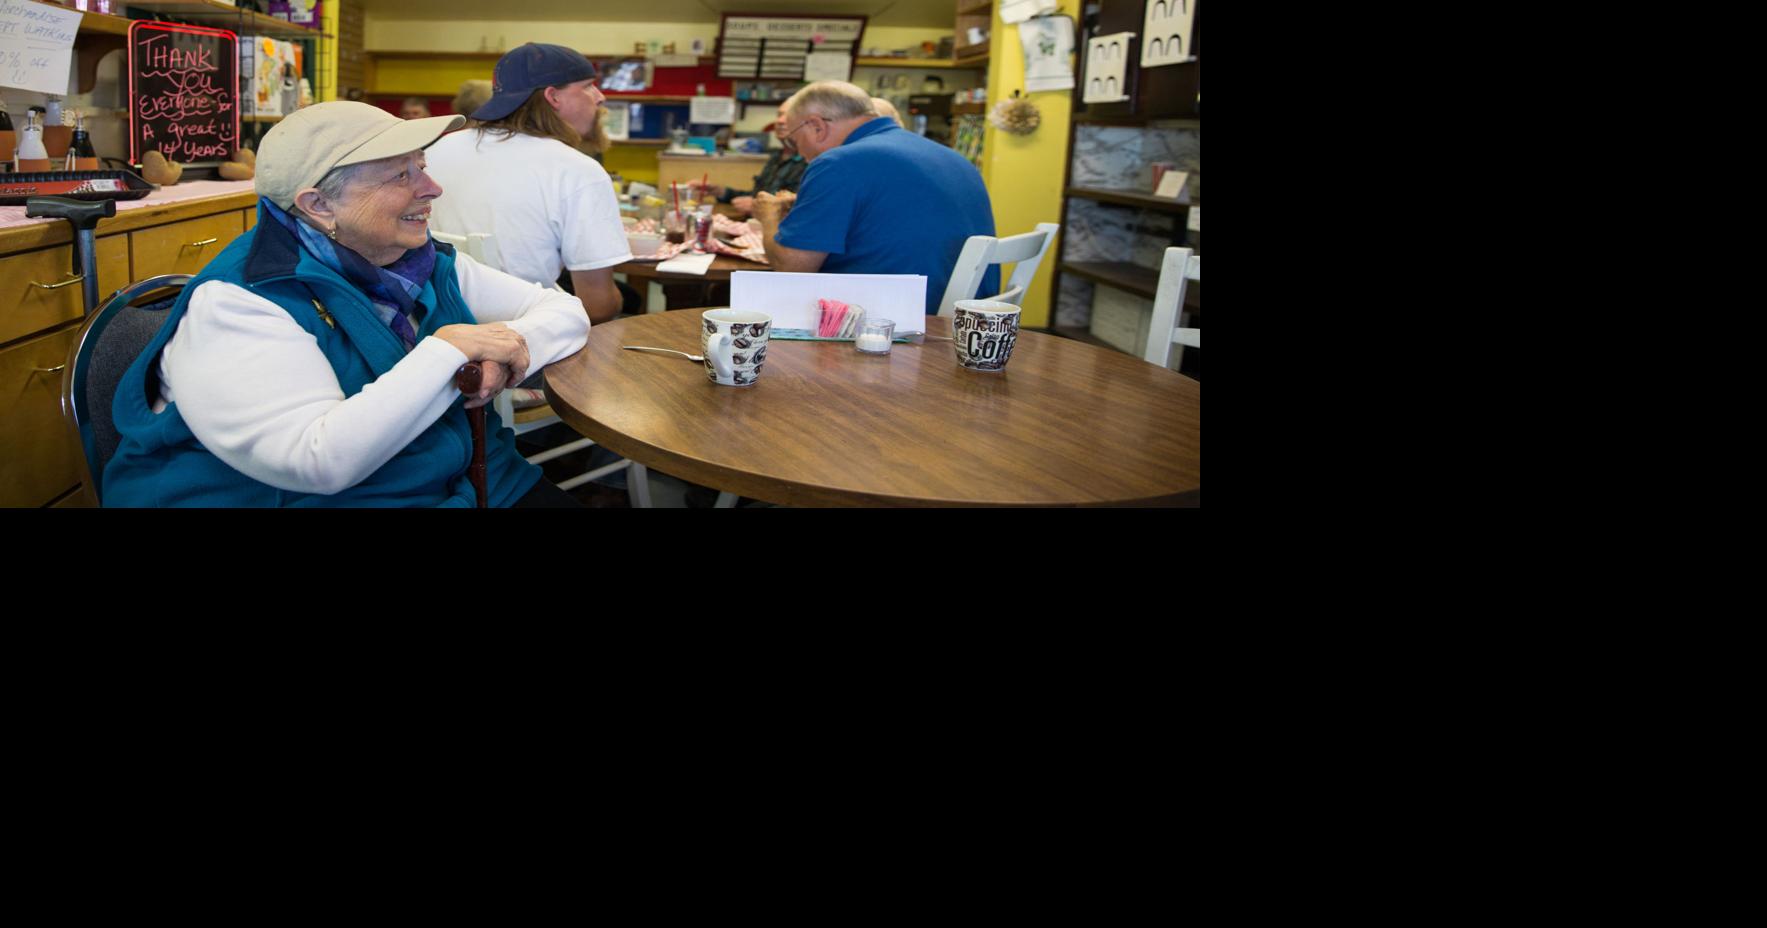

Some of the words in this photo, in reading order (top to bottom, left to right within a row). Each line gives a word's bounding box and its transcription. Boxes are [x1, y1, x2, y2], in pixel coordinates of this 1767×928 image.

[139, 34, 218, 69] THANK
[143, 123, 154, 140] A
[159, 141, 176, 161] 14
